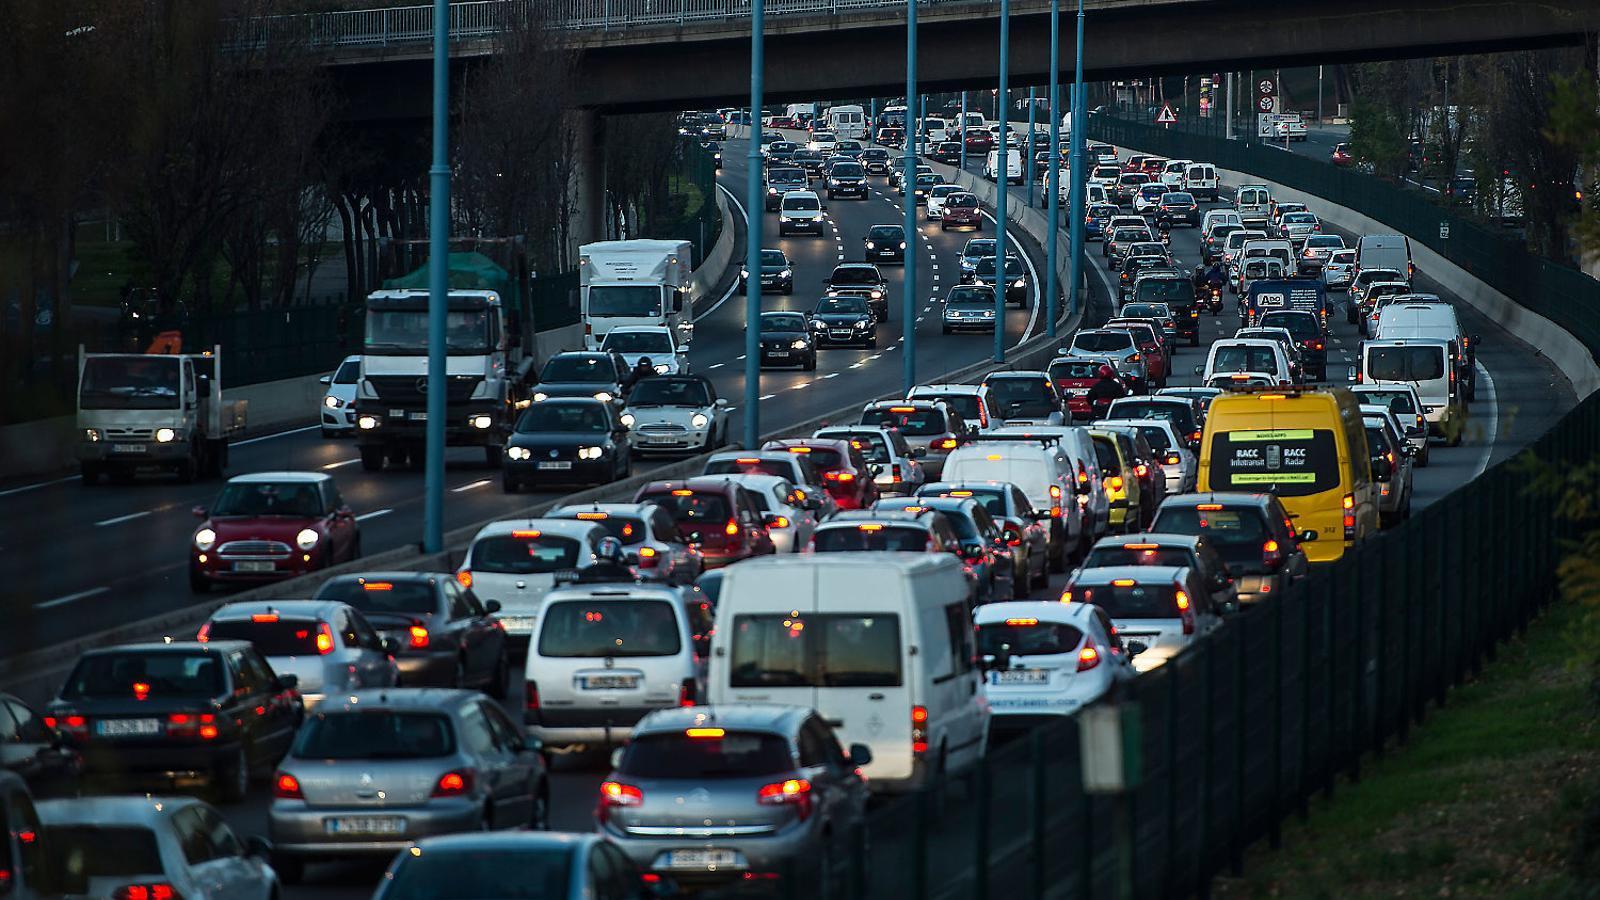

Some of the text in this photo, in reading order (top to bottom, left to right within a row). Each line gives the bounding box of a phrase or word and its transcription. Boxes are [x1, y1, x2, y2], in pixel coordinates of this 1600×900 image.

[1262, 115, 1269, 123] 4
[1236, 449, 1259, 457] RACC
[1284, 448, 1306, 457] RACC
[1231, 458, 1265, 466] Infotransit
[1285, 457, 1305, 465] Radar
